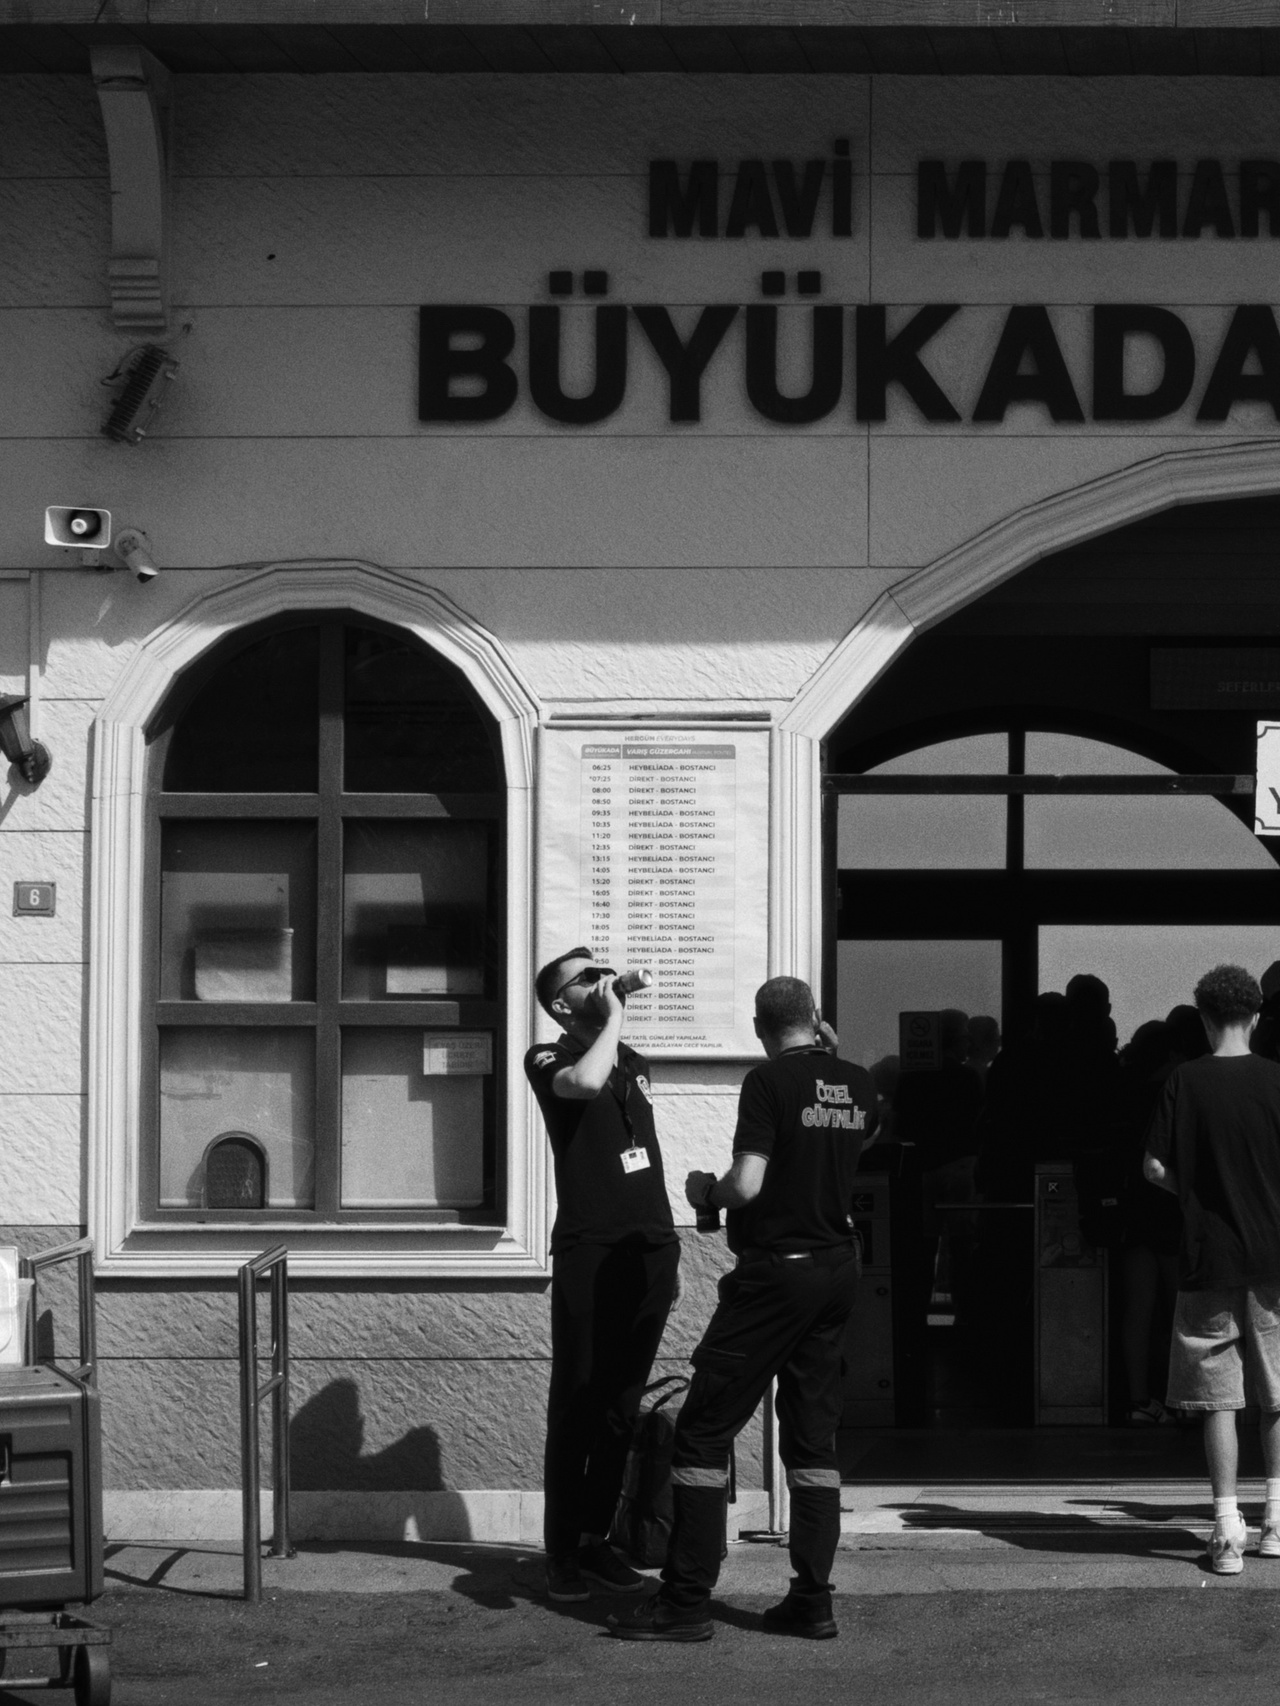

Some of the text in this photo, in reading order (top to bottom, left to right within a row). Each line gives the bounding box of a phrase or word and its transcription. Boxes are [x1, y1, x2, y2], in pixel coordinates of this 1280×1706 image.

[649, 139, 852, 238] MAVİ
[30, 888, 40, 906] 6
[816, 1079, 852, 1104] ÖZEL
